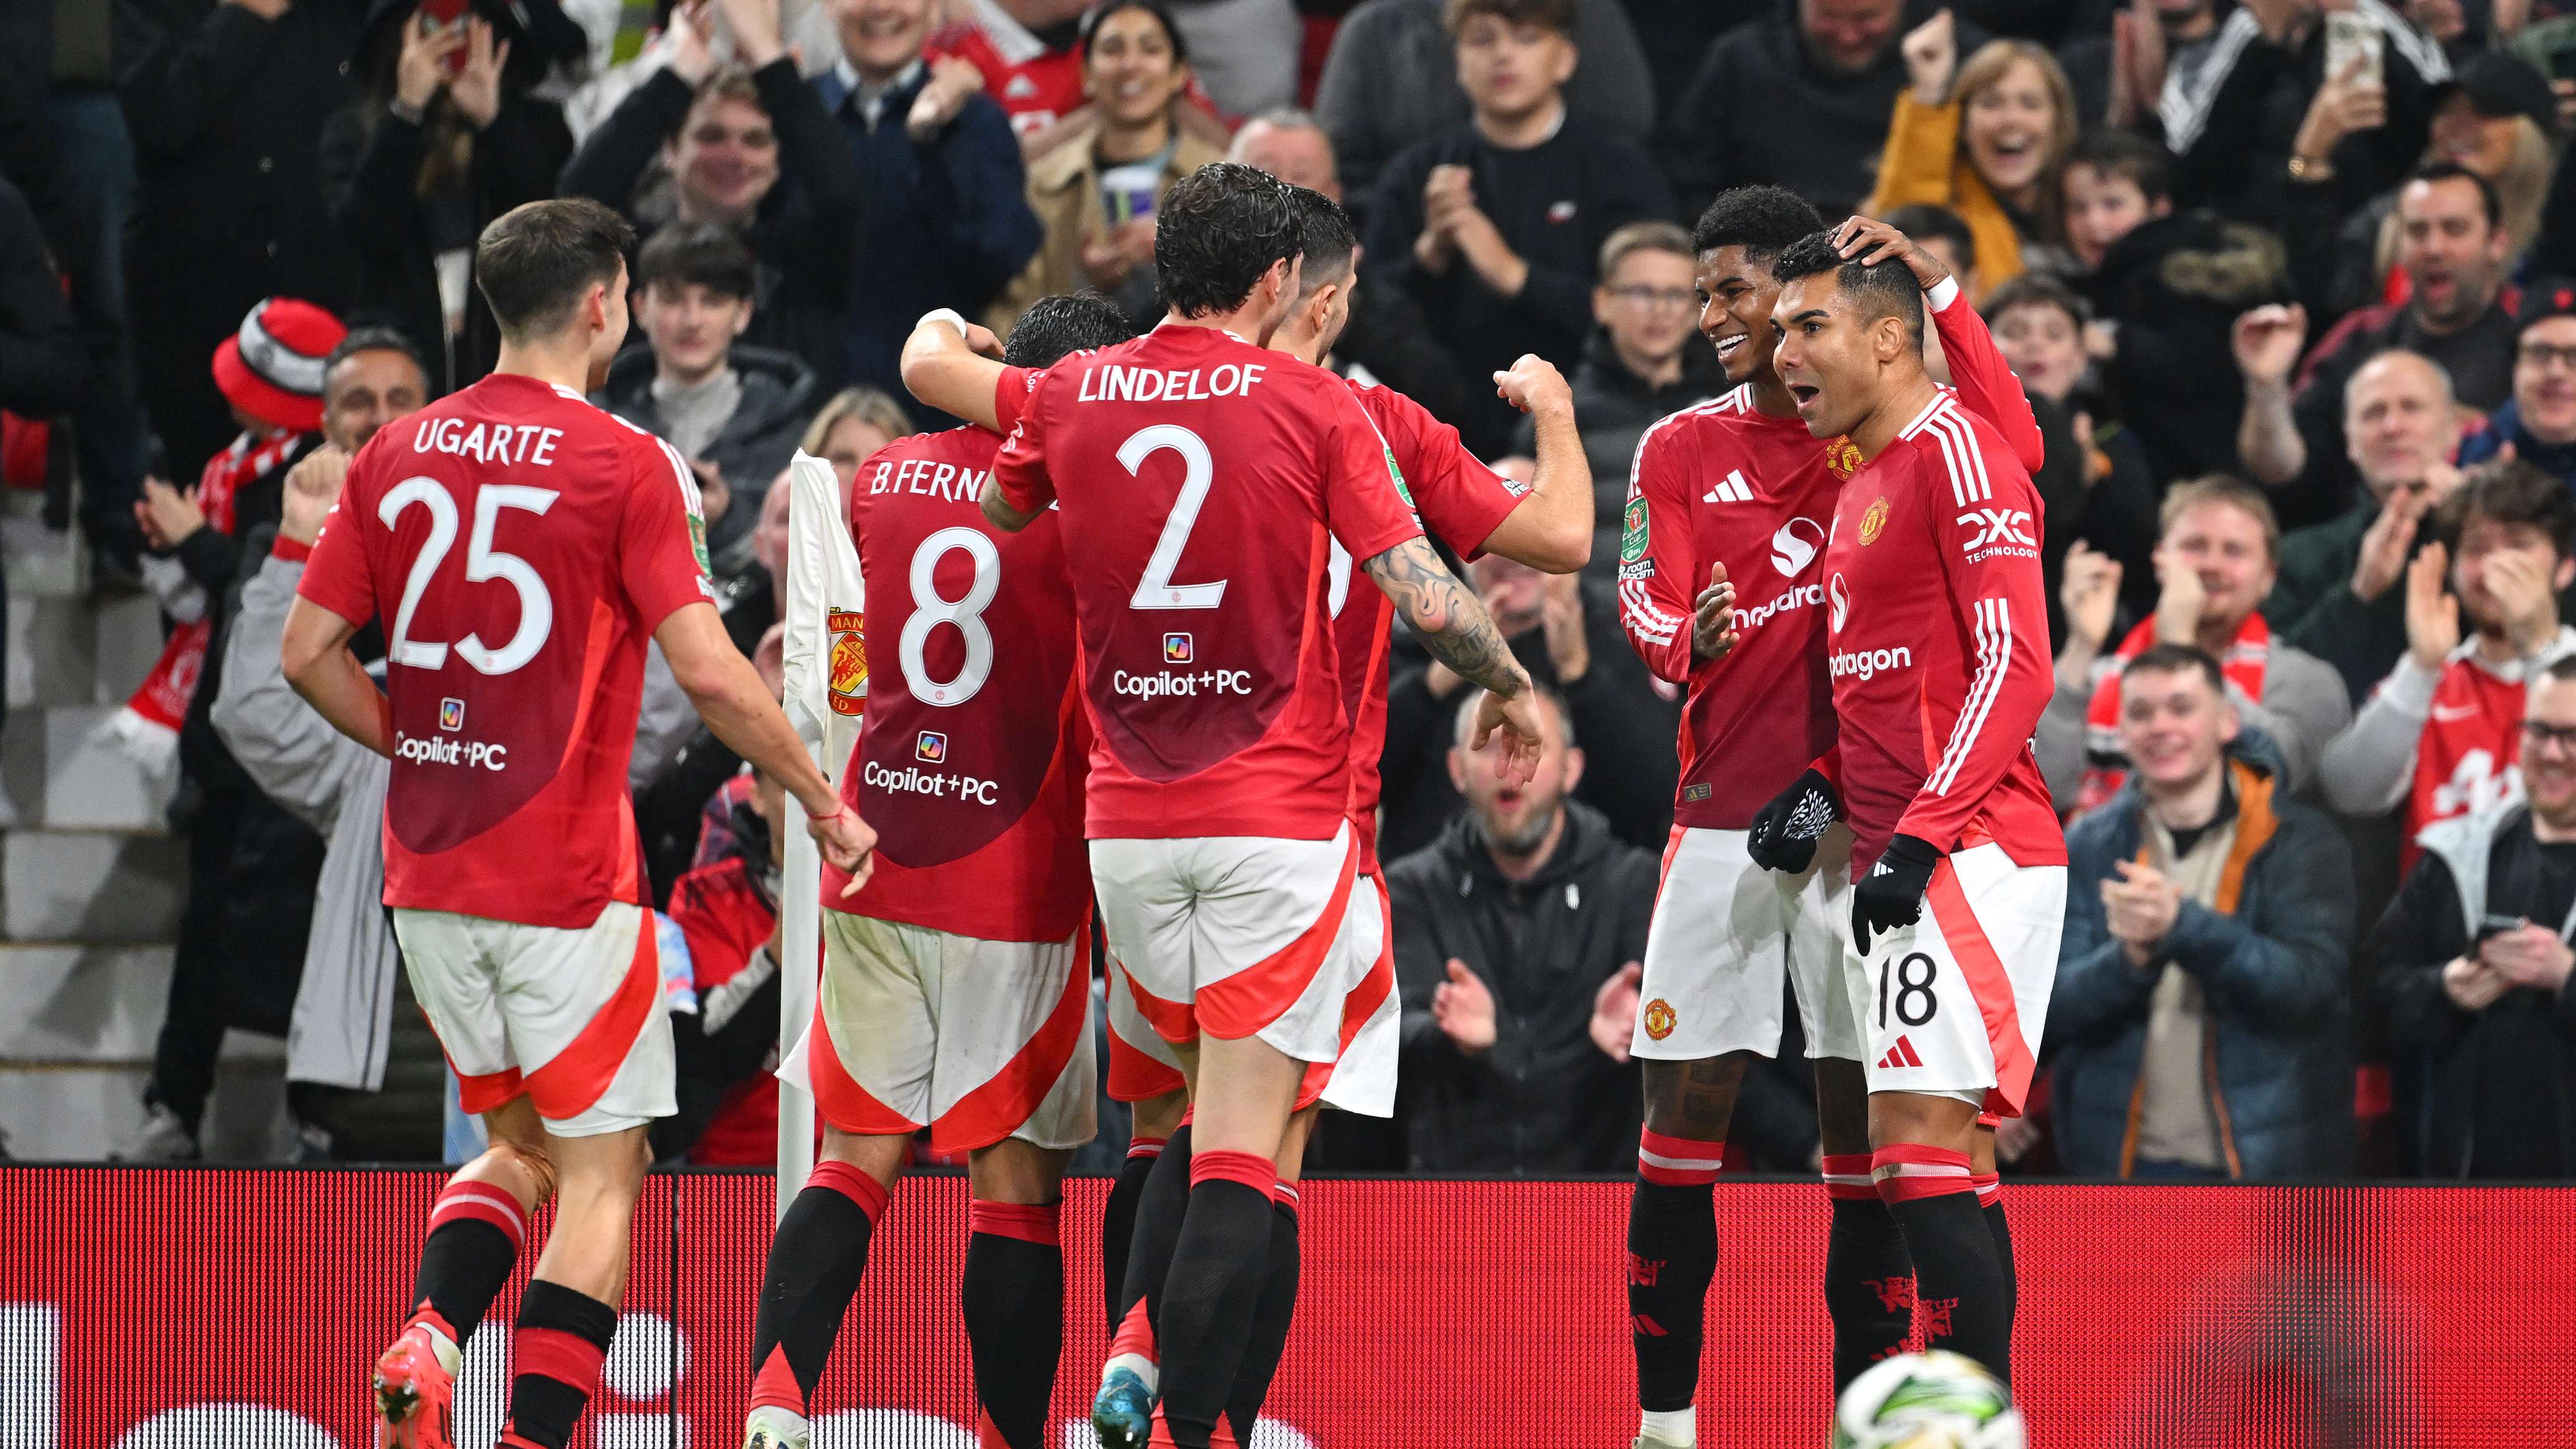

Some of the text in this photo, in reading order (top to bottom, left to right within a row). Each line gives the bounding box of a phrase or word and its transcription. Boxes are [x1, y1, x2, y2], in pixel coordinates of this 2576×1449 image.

[1078, 363, 1267, 403] LINDELOF
[414, 418, 564, 467] UGARTE
[870, 459, 986, 503] B.FERN
[1115, 424, 1228, 609] 2
[1956, 508, 2037, 552] DXC
[1629, 533, 1641, 546] Cup
[1966, 546, 2038, 564] TECHNOLOGY
[378, 476, 561, 675] 25
[1626, 560, 1650, 573] room
[831, 617, 864, 629] MAN
[898, 526, 1001, 707] 8
[1829, 646, 1911, 686] pdragon
[1878, 952, 1938, 1032] 18
